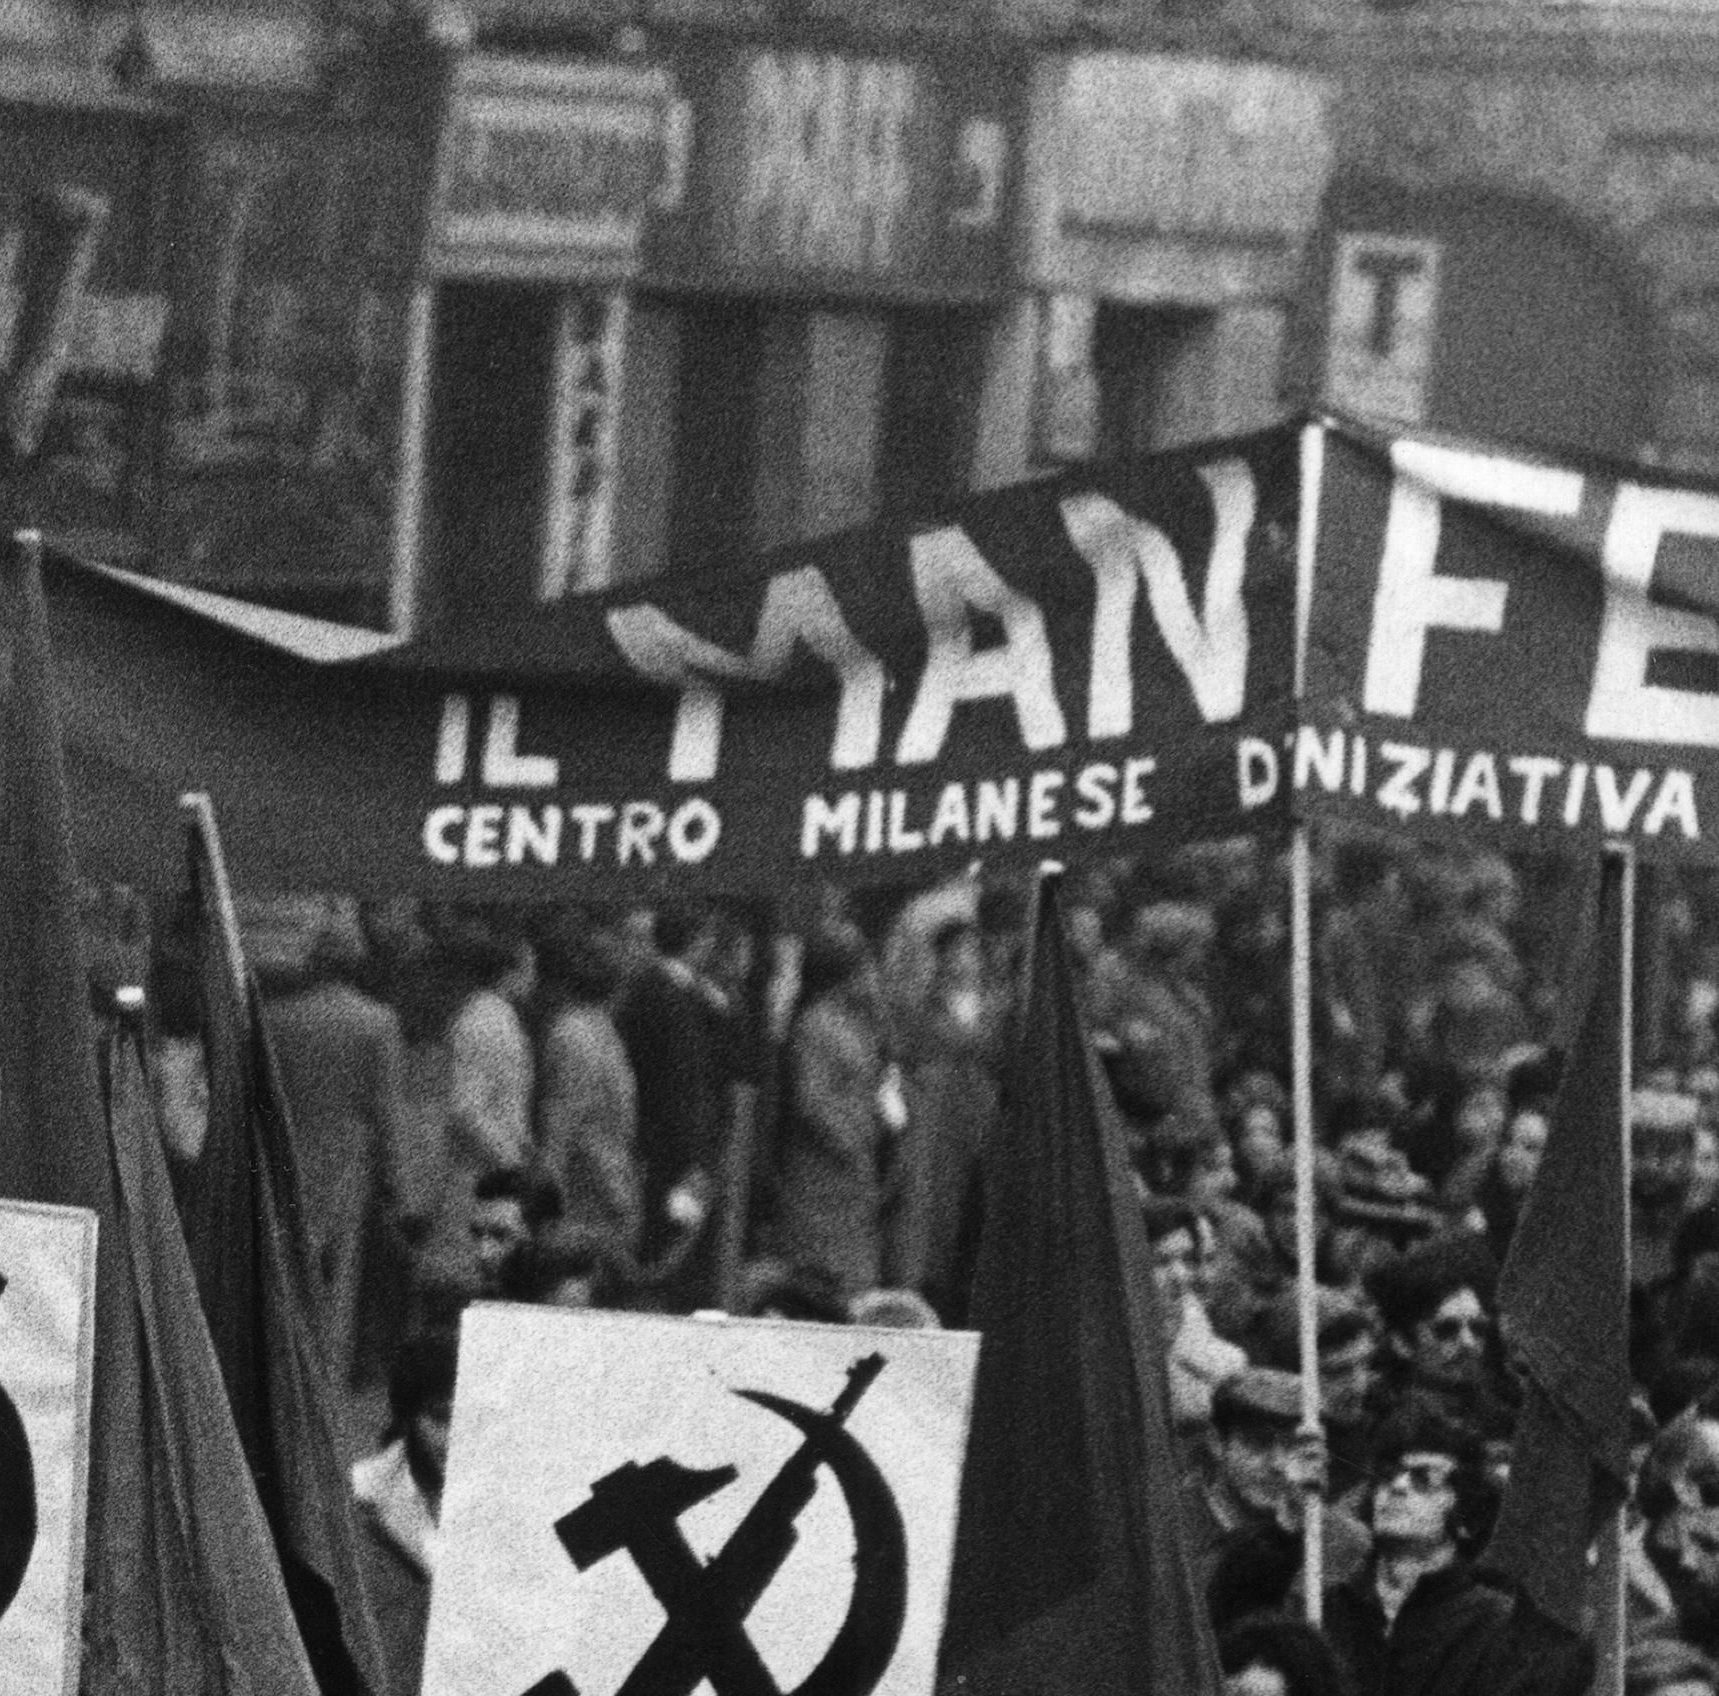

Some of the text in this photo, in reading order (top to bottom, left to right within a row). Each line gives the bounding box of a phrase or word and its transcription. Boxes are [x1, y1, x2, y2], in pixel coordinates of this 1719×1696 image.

[434, 694, 559, 788] IL
[422, 799, 722, 866] CENTRO
[801, 757, 1156, 858] MILANESE
